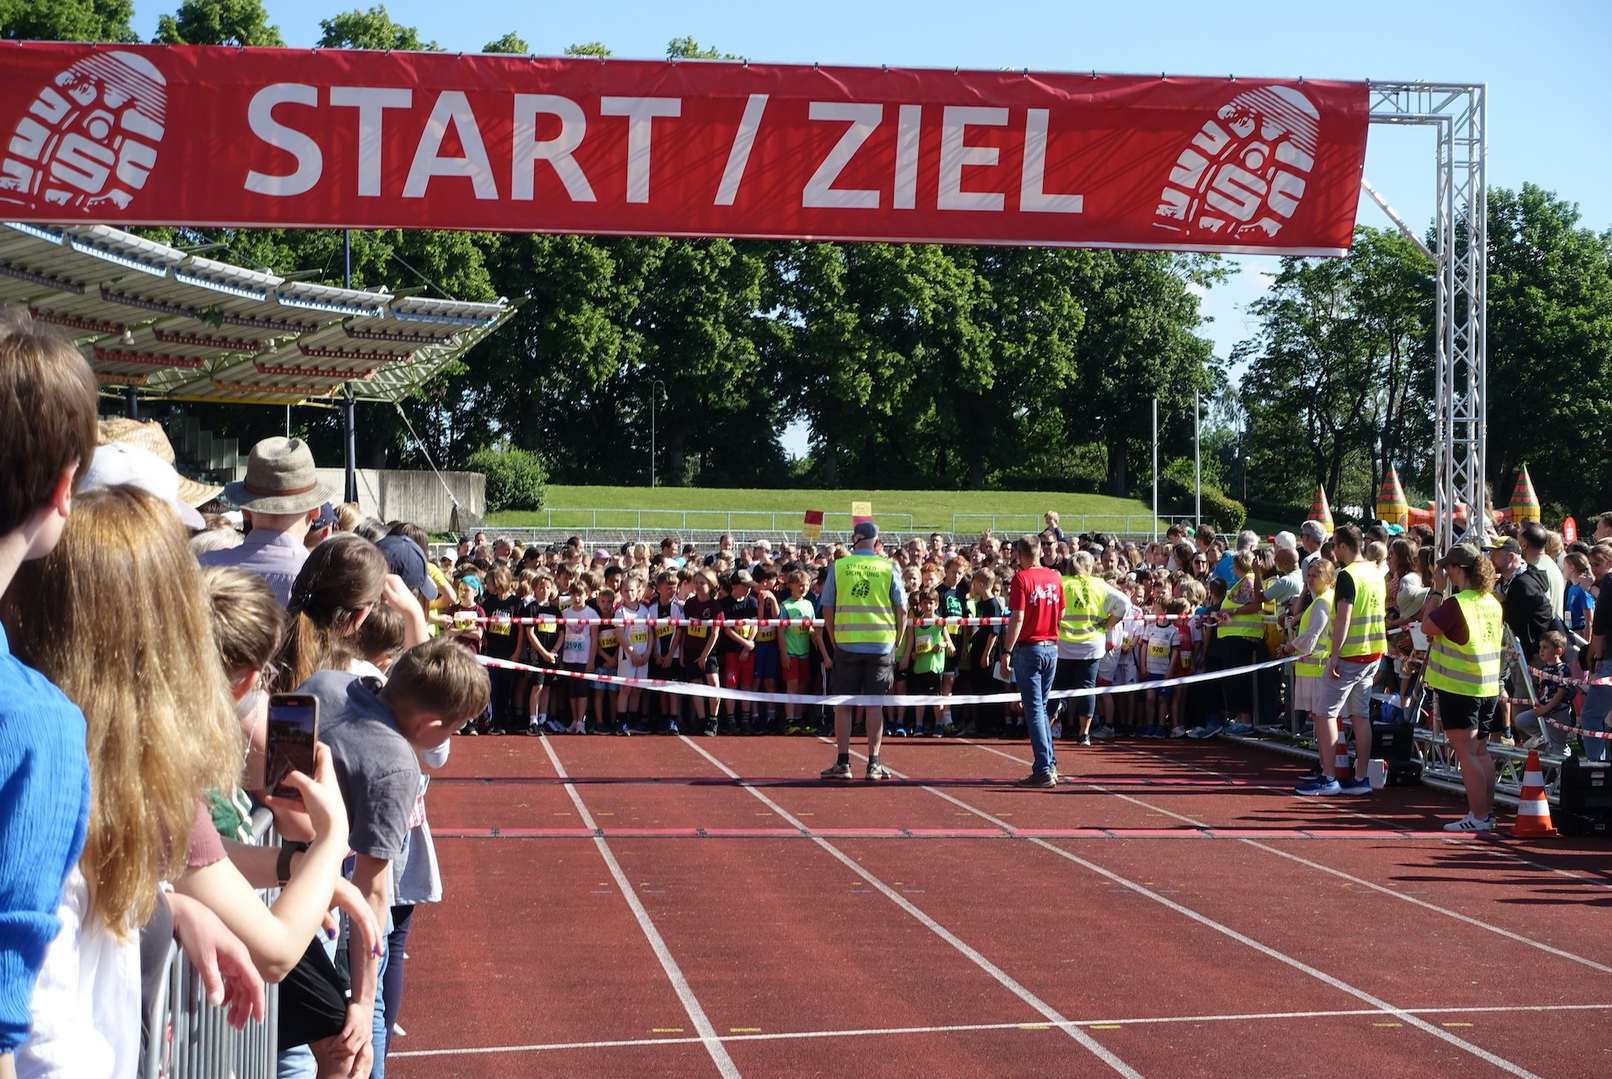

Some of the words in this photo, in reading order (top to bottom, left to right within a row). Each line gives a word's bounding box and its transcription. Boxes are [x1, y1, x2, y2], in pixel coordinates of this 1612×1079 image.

[244, 83, 682, 205] START
[714, 93, 769, 206] /
[803, 102, 1084, 214] ZIEL
[565, 641, 583, 650] 2598
[1152, 646, 1164, 654] 920
